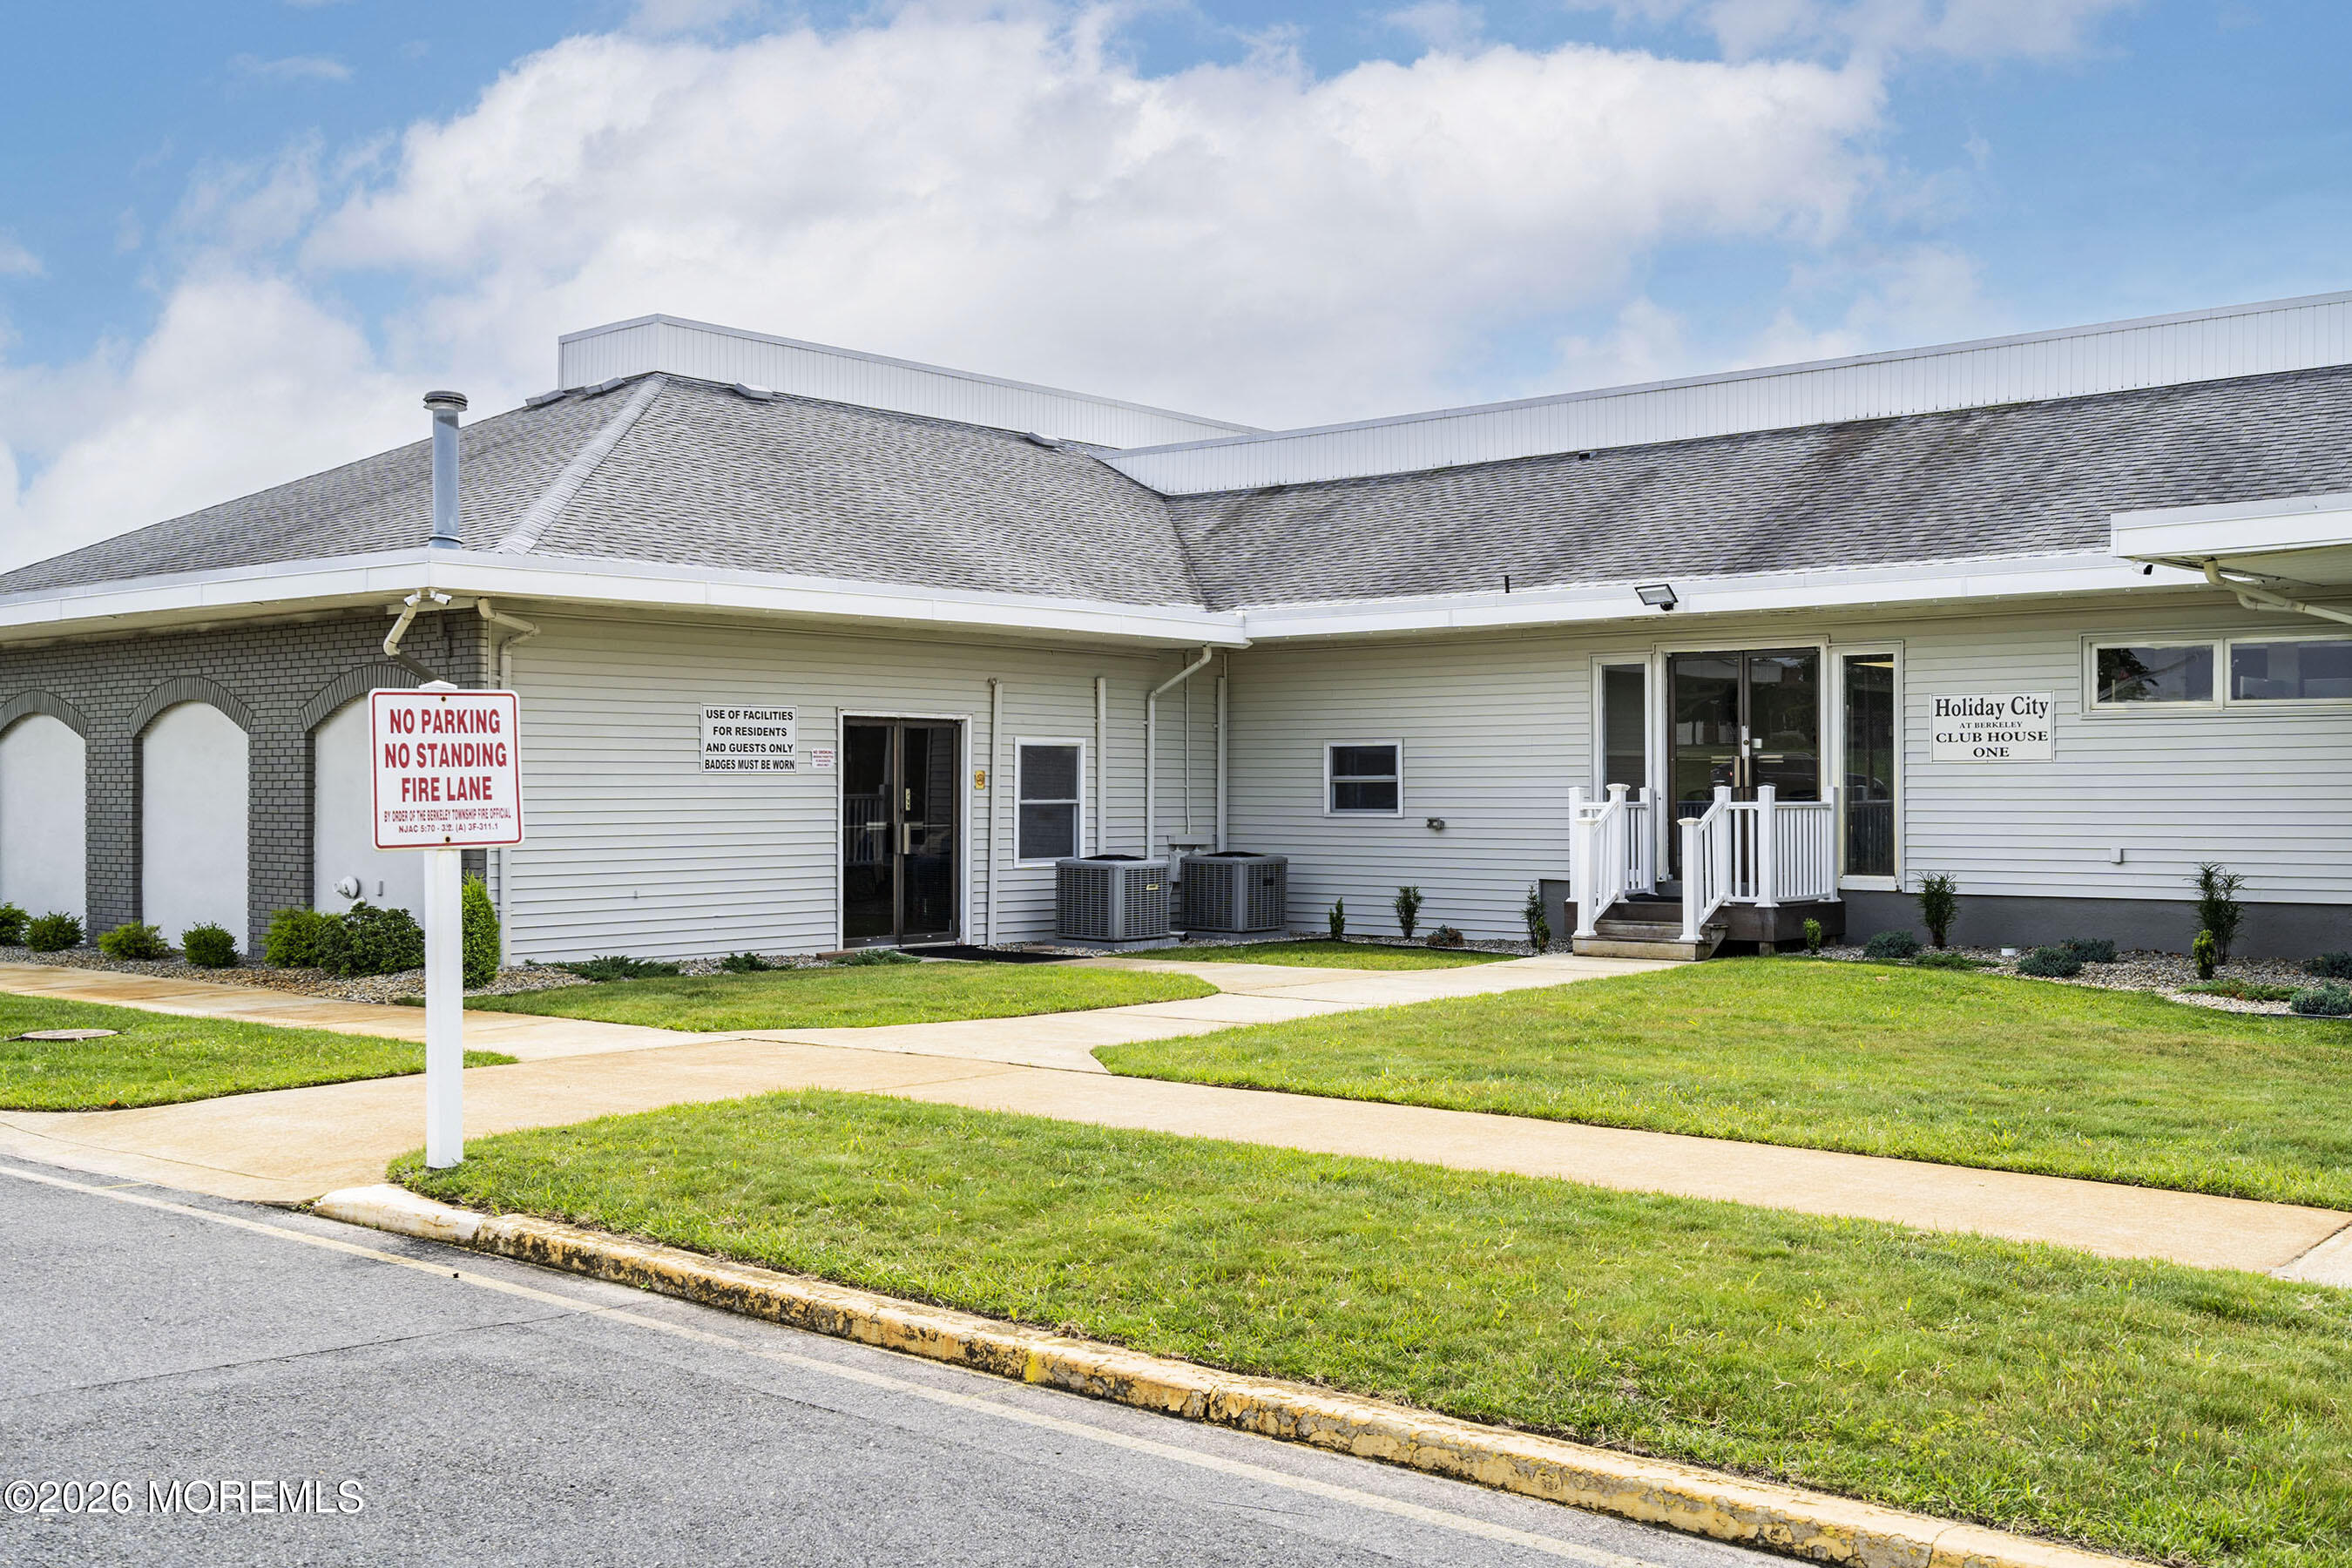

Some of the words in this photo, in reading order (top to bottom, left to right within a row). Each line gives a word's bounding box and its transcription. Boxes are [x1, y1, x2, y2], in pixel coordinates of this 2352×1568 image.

[1935, 698, 2005, 720] Holiday
[2011, 696, 2049, 719] City
[389, 708, 415, 734] NO
[421, 708, 501, 734] PARKING
[706, 709, 726, 720] USE
[728, 710, 740, 720] OF
[743, 710, 794, 721] FACILITIES
[713, 727, 733, 736] FOR
[735, 727, 787, 737] RESIDENTS
[1936, 732, 1982, 743] CLUB
[1987, 731, 2048, 742] HOUSE
[706, 743, 727, 753] AND
[729, 743, 767, 753] GUESTS
[769, 743, 794, 754] ONLY
[1973, 747, 2010, 758] ONE
[384, 743, 410, 768] NO
[416, 742, 507, 768] STANDING
[705, 760, 736, 770] BADGES
[738, 760, 759, 770] MUST
[760, 760, 771, 770] BE
[773, 760, 794, 770] WORN
[402, 777, 440, 802] FIRE
[447, 776, 492, 801] LANE
[384, 810, 390, 822] BY
[392, 810, 409, 822] ORDER
[409, 810, 416, 821] OF
[416, 809, 426, 821] THE
[427, 809, 450, 821] BERKELEY
[452, 808, 476, 820] TOWNSHIP
[477, 808, 489, 819] FIRE
[490, 808, 511, 819] OFFICIAL
[399, 824, 418, 833] NJAC
[456, 823, 466, 833] (A)
[468, 822, 498, 831] 3F-311.1
